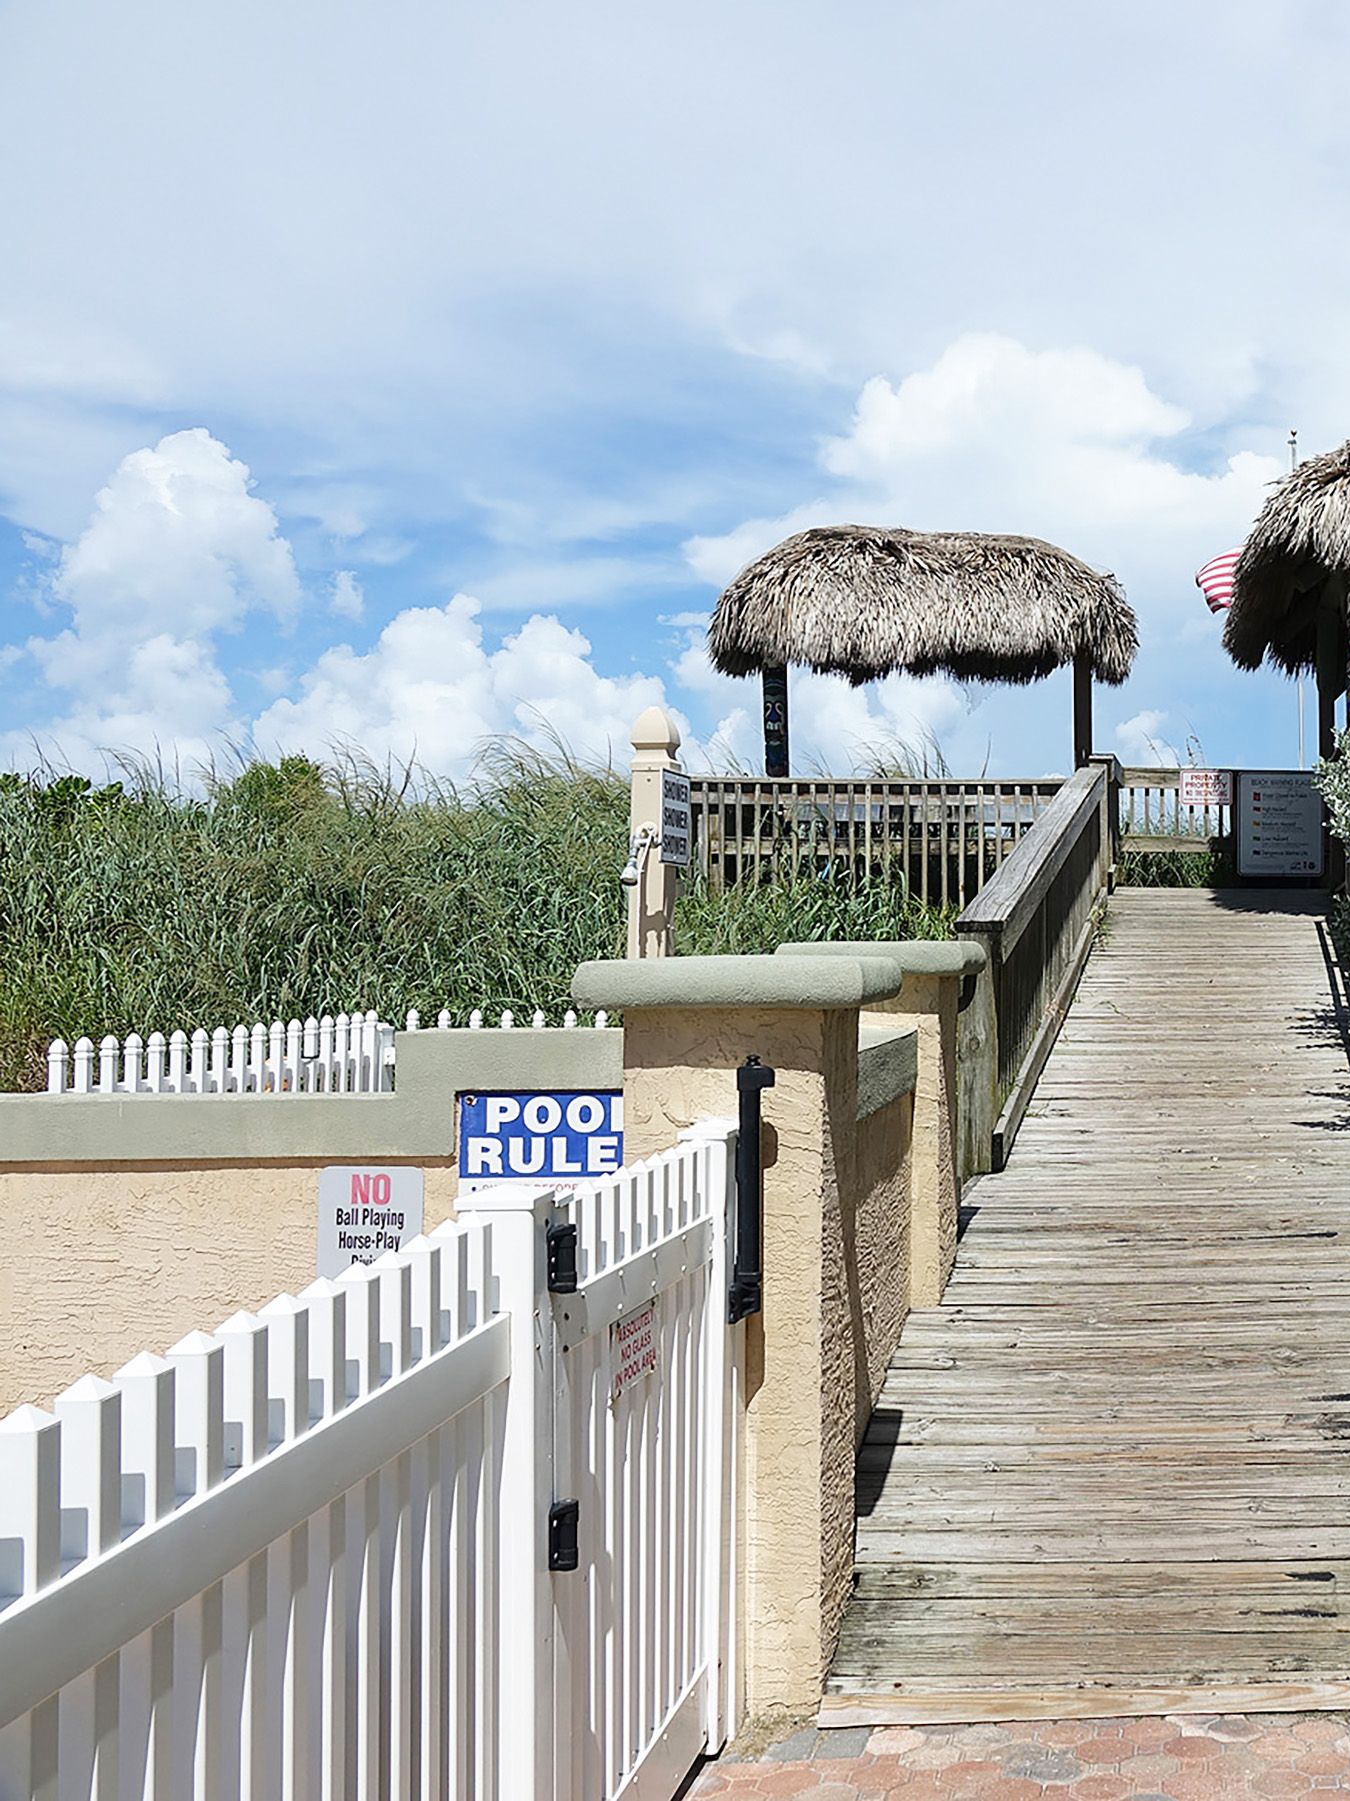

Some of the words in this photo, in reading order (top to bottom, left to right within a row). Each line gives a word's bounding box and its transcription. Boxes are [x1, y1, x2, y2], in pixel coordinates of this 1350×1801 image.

[663, 780, 688, 803] SHOWER
[663, 806, 688, 829] SHOWER
[662, 833, 687, 855] SHOWER
[351, 1173, 391, 1205] NO
[336, 1208, 359, 1226] Ball
[362, 1208, 405, 1230] Playing
[338, 1231, 401, 1252] Horse-Play
[618, 1308, 654, 1343] ABSOLUTELY
[621, 1343, 632, 1362] NO
[632, 1329, 652, 1355] GLASS
[615, 1373, 623, 1389] IN
[624, 1361, 641, 1382] POOL
[641, 1346, 657, 1367] AREA
